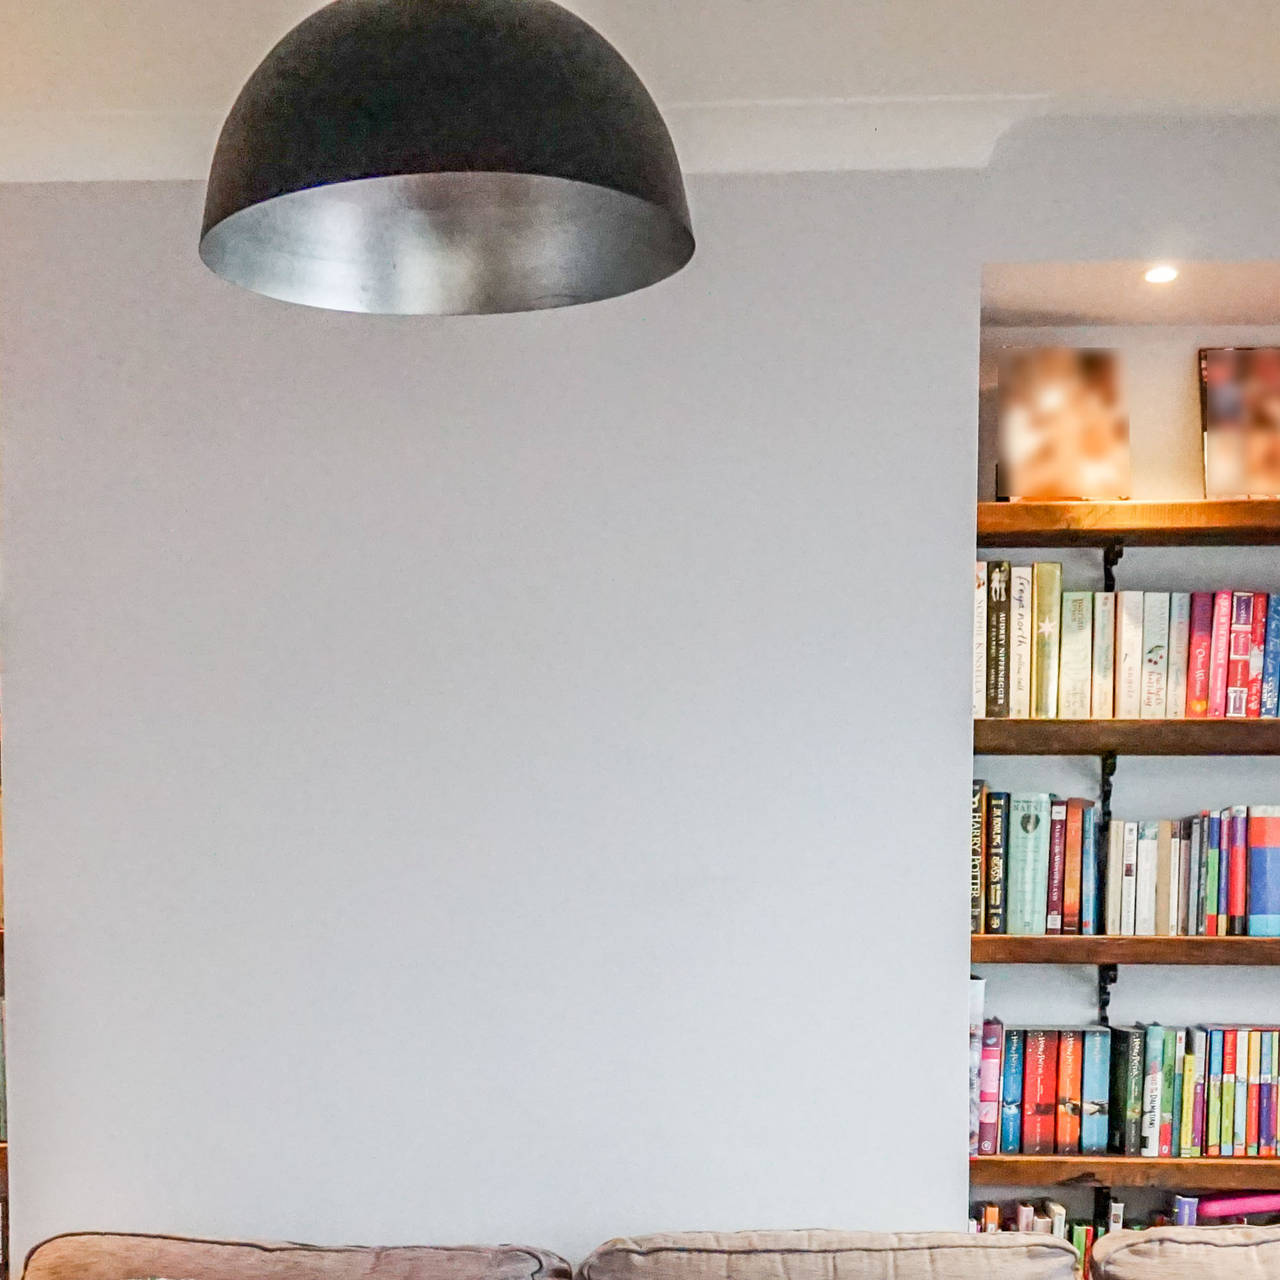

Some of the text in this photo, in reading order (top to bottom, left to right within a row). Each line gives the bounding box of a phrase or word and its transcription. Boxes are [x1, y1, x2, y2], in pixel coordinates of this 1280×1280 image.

[1012, 575, 1030, 608] freya
[1015, 613, 1027, 647] north
[995, 612, 1007, 704] AUDREY NIFFENEGGER
[971, 813, 981, 898] HARRY POTTER
[1149, 1094, 1158, 1129] DALMATIANS
